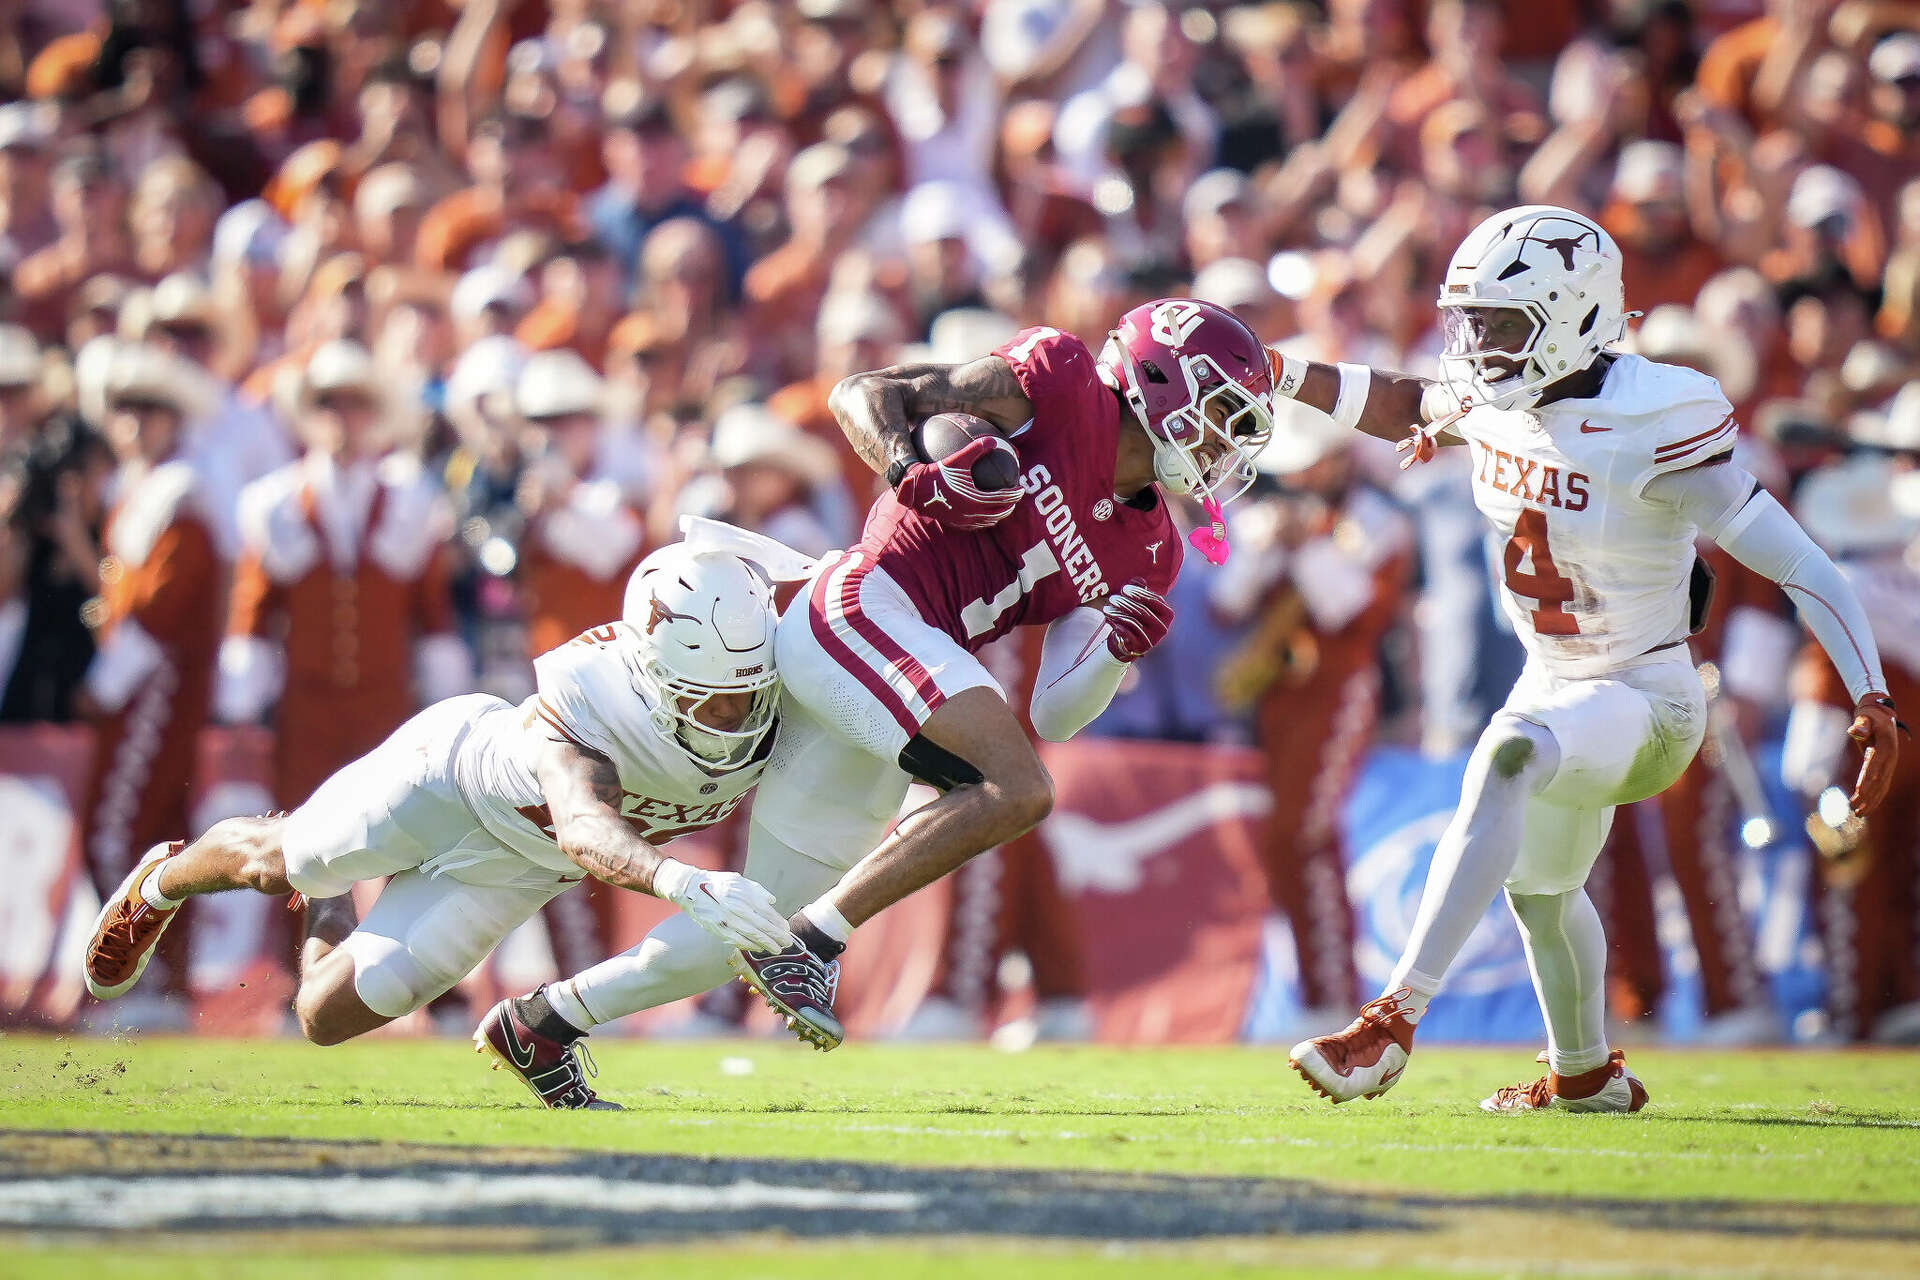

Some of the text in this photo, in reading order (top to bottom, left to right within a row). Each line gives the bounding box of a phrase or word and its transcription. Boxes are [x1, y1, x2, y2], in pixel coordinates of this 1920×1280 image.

[1150, 301, 1206, 349] OU
[1479, 440, 1591, 512] TEXAS
[1019, 464, 1110, 604] SOONERS
[1504, 507, 1581, 635] 4
[961, 538, 1061, 640] 1
[736, 664, 764, 678] HORNS
